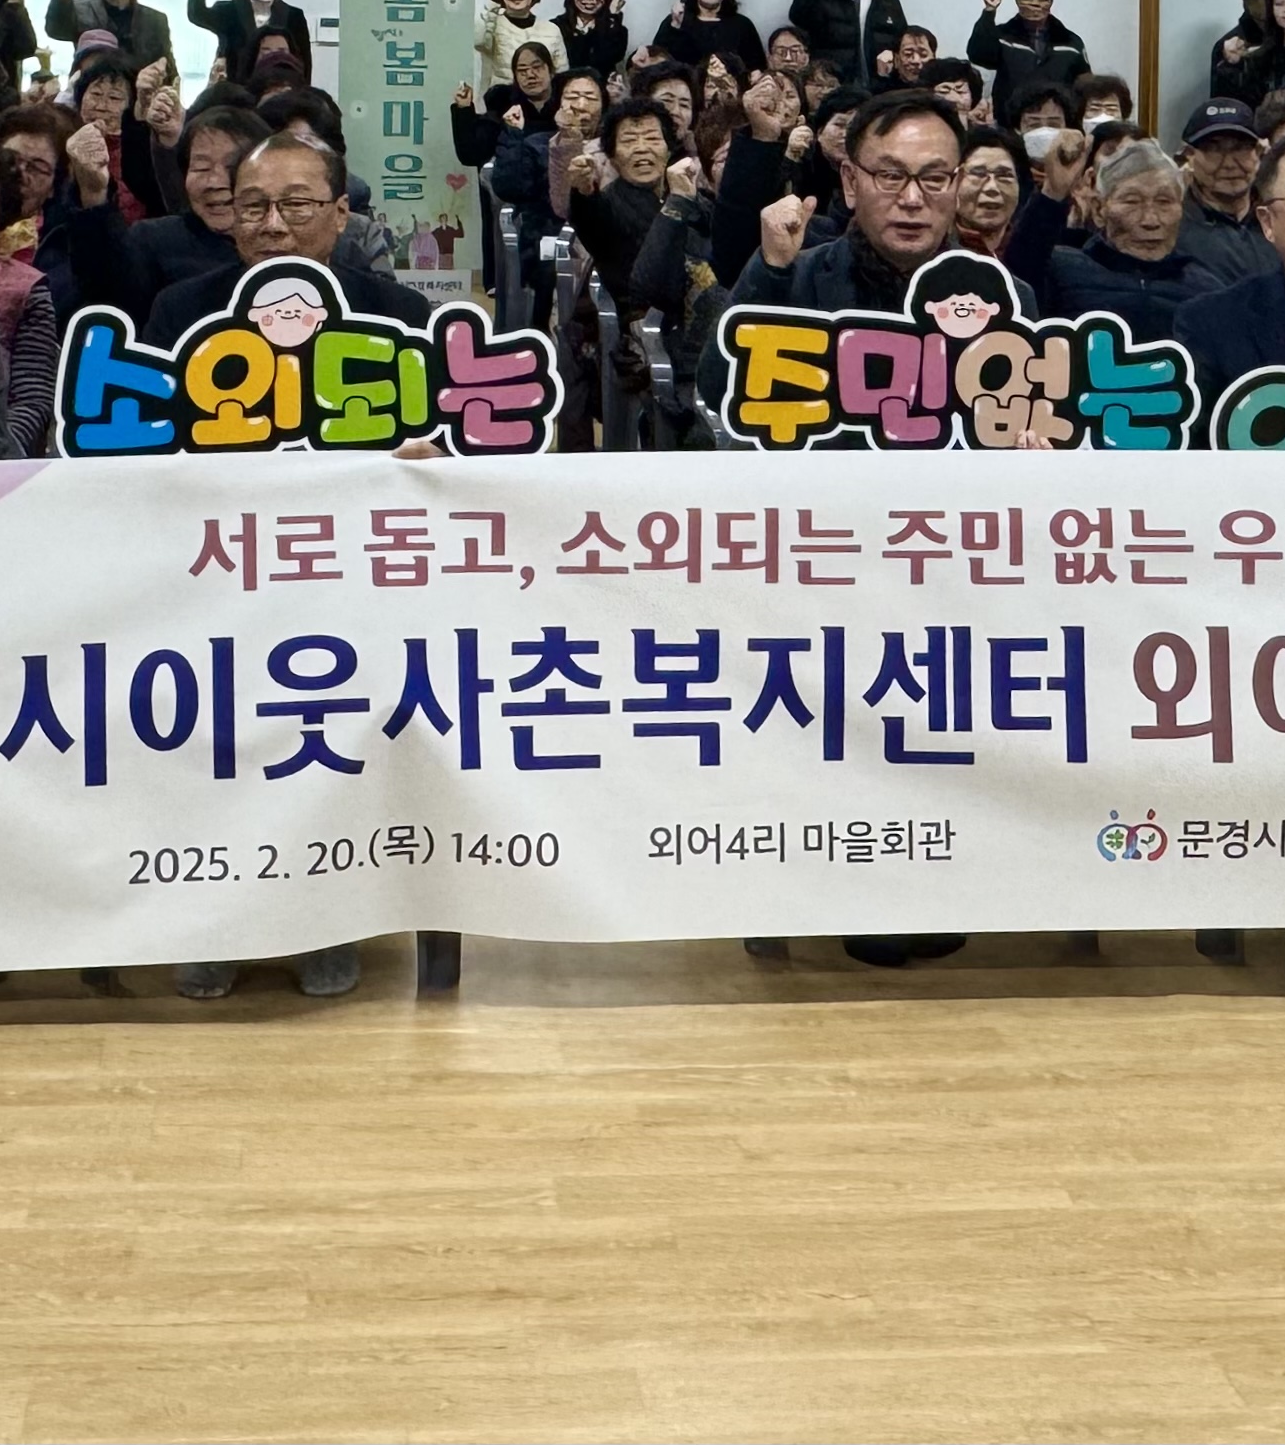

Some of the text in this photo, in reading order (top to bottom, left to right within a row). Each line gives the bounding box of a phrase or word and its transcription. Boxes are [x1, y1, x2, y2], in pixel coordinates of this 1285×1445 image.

[75, 321, 544, 449] 소외되는
[735, 325, 1182, 450] 주민없는
[189, 512, 343, 592] 서로
[363, 508, 536, 591] 돕고,
[556, 507, 862, 587] 소외되는
[882, 507, 1026, 586] 주민
[1049, 507, 1195, 586] 없는
[128, 824, 561, 886] 2025. 2. 20.(목) 14:00
[648, 818, 958, 867] 외어4리 마을회관
